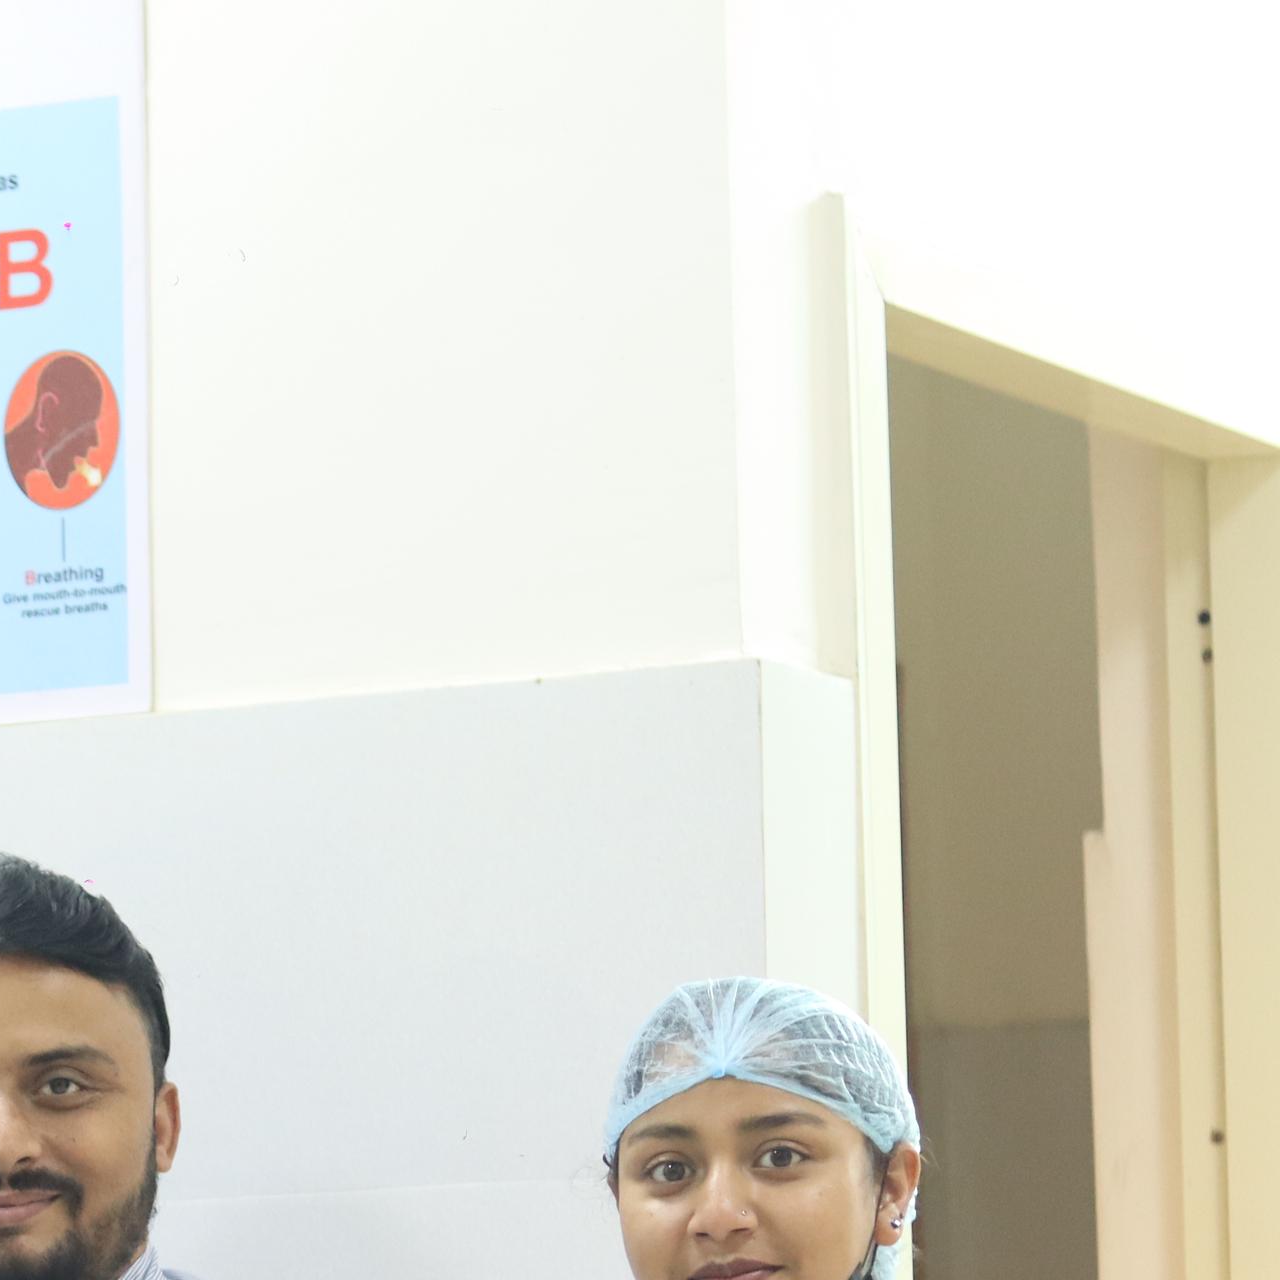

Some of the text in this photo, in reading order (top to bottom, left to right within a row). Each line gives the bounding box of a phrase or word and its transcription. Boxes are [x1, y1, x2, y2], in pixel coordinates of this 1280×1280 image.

[25, 566, 105, 586] Breathing
[2, 583, 127, 605] Give mouth-to-mouth
[21, 601, 109, 619] rescue breaths
